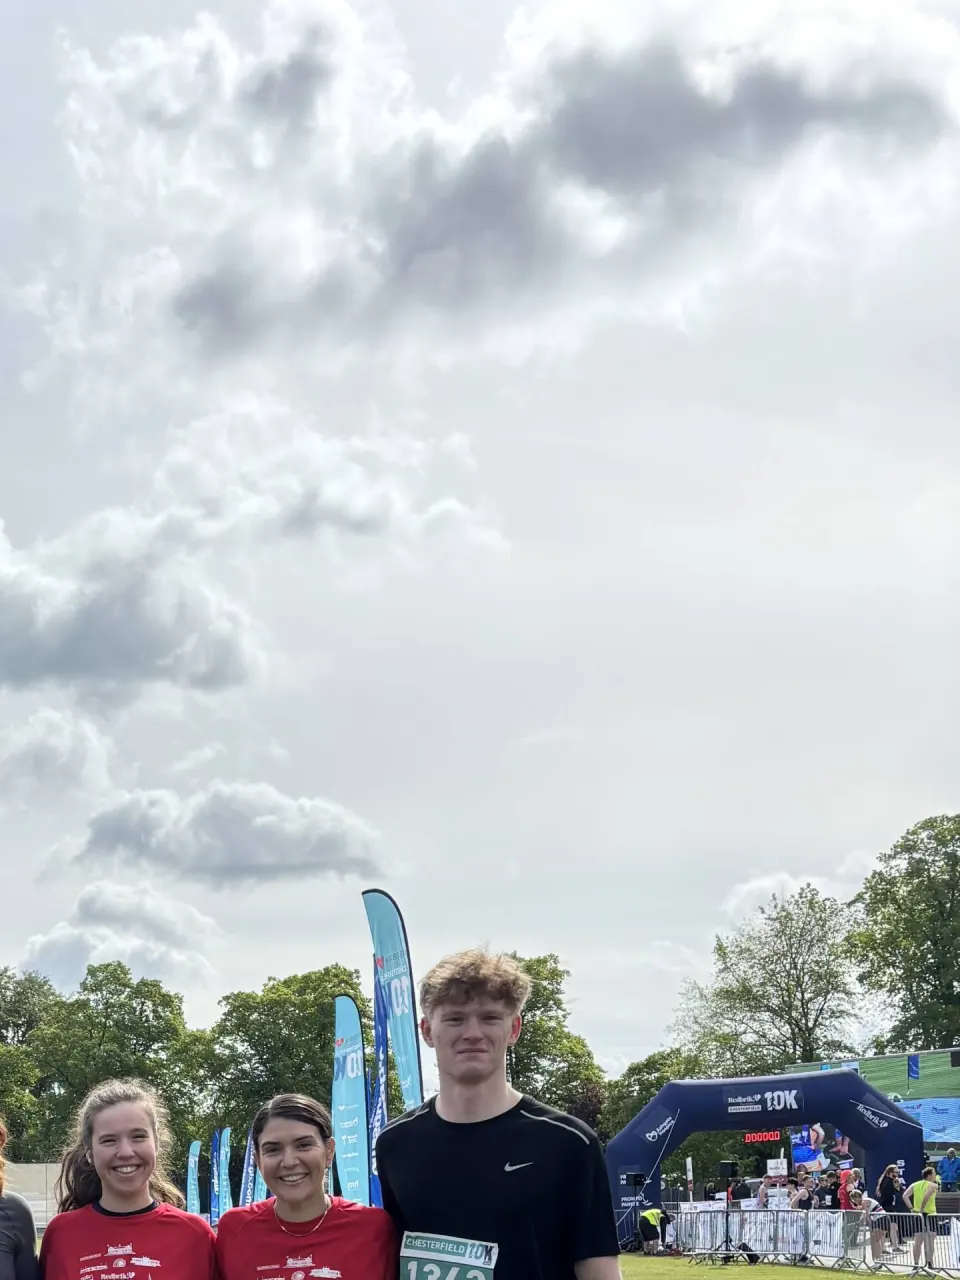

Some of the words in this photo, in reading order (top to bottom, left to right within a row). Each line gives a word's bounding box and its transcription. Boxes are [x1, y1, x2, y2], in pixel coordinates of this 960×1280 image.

[764, 1090, 798, 1111] 10K
[406, 1238, 465, 1254] CHESTERFIELD
[466, 1242, 493, 1262] 10K
